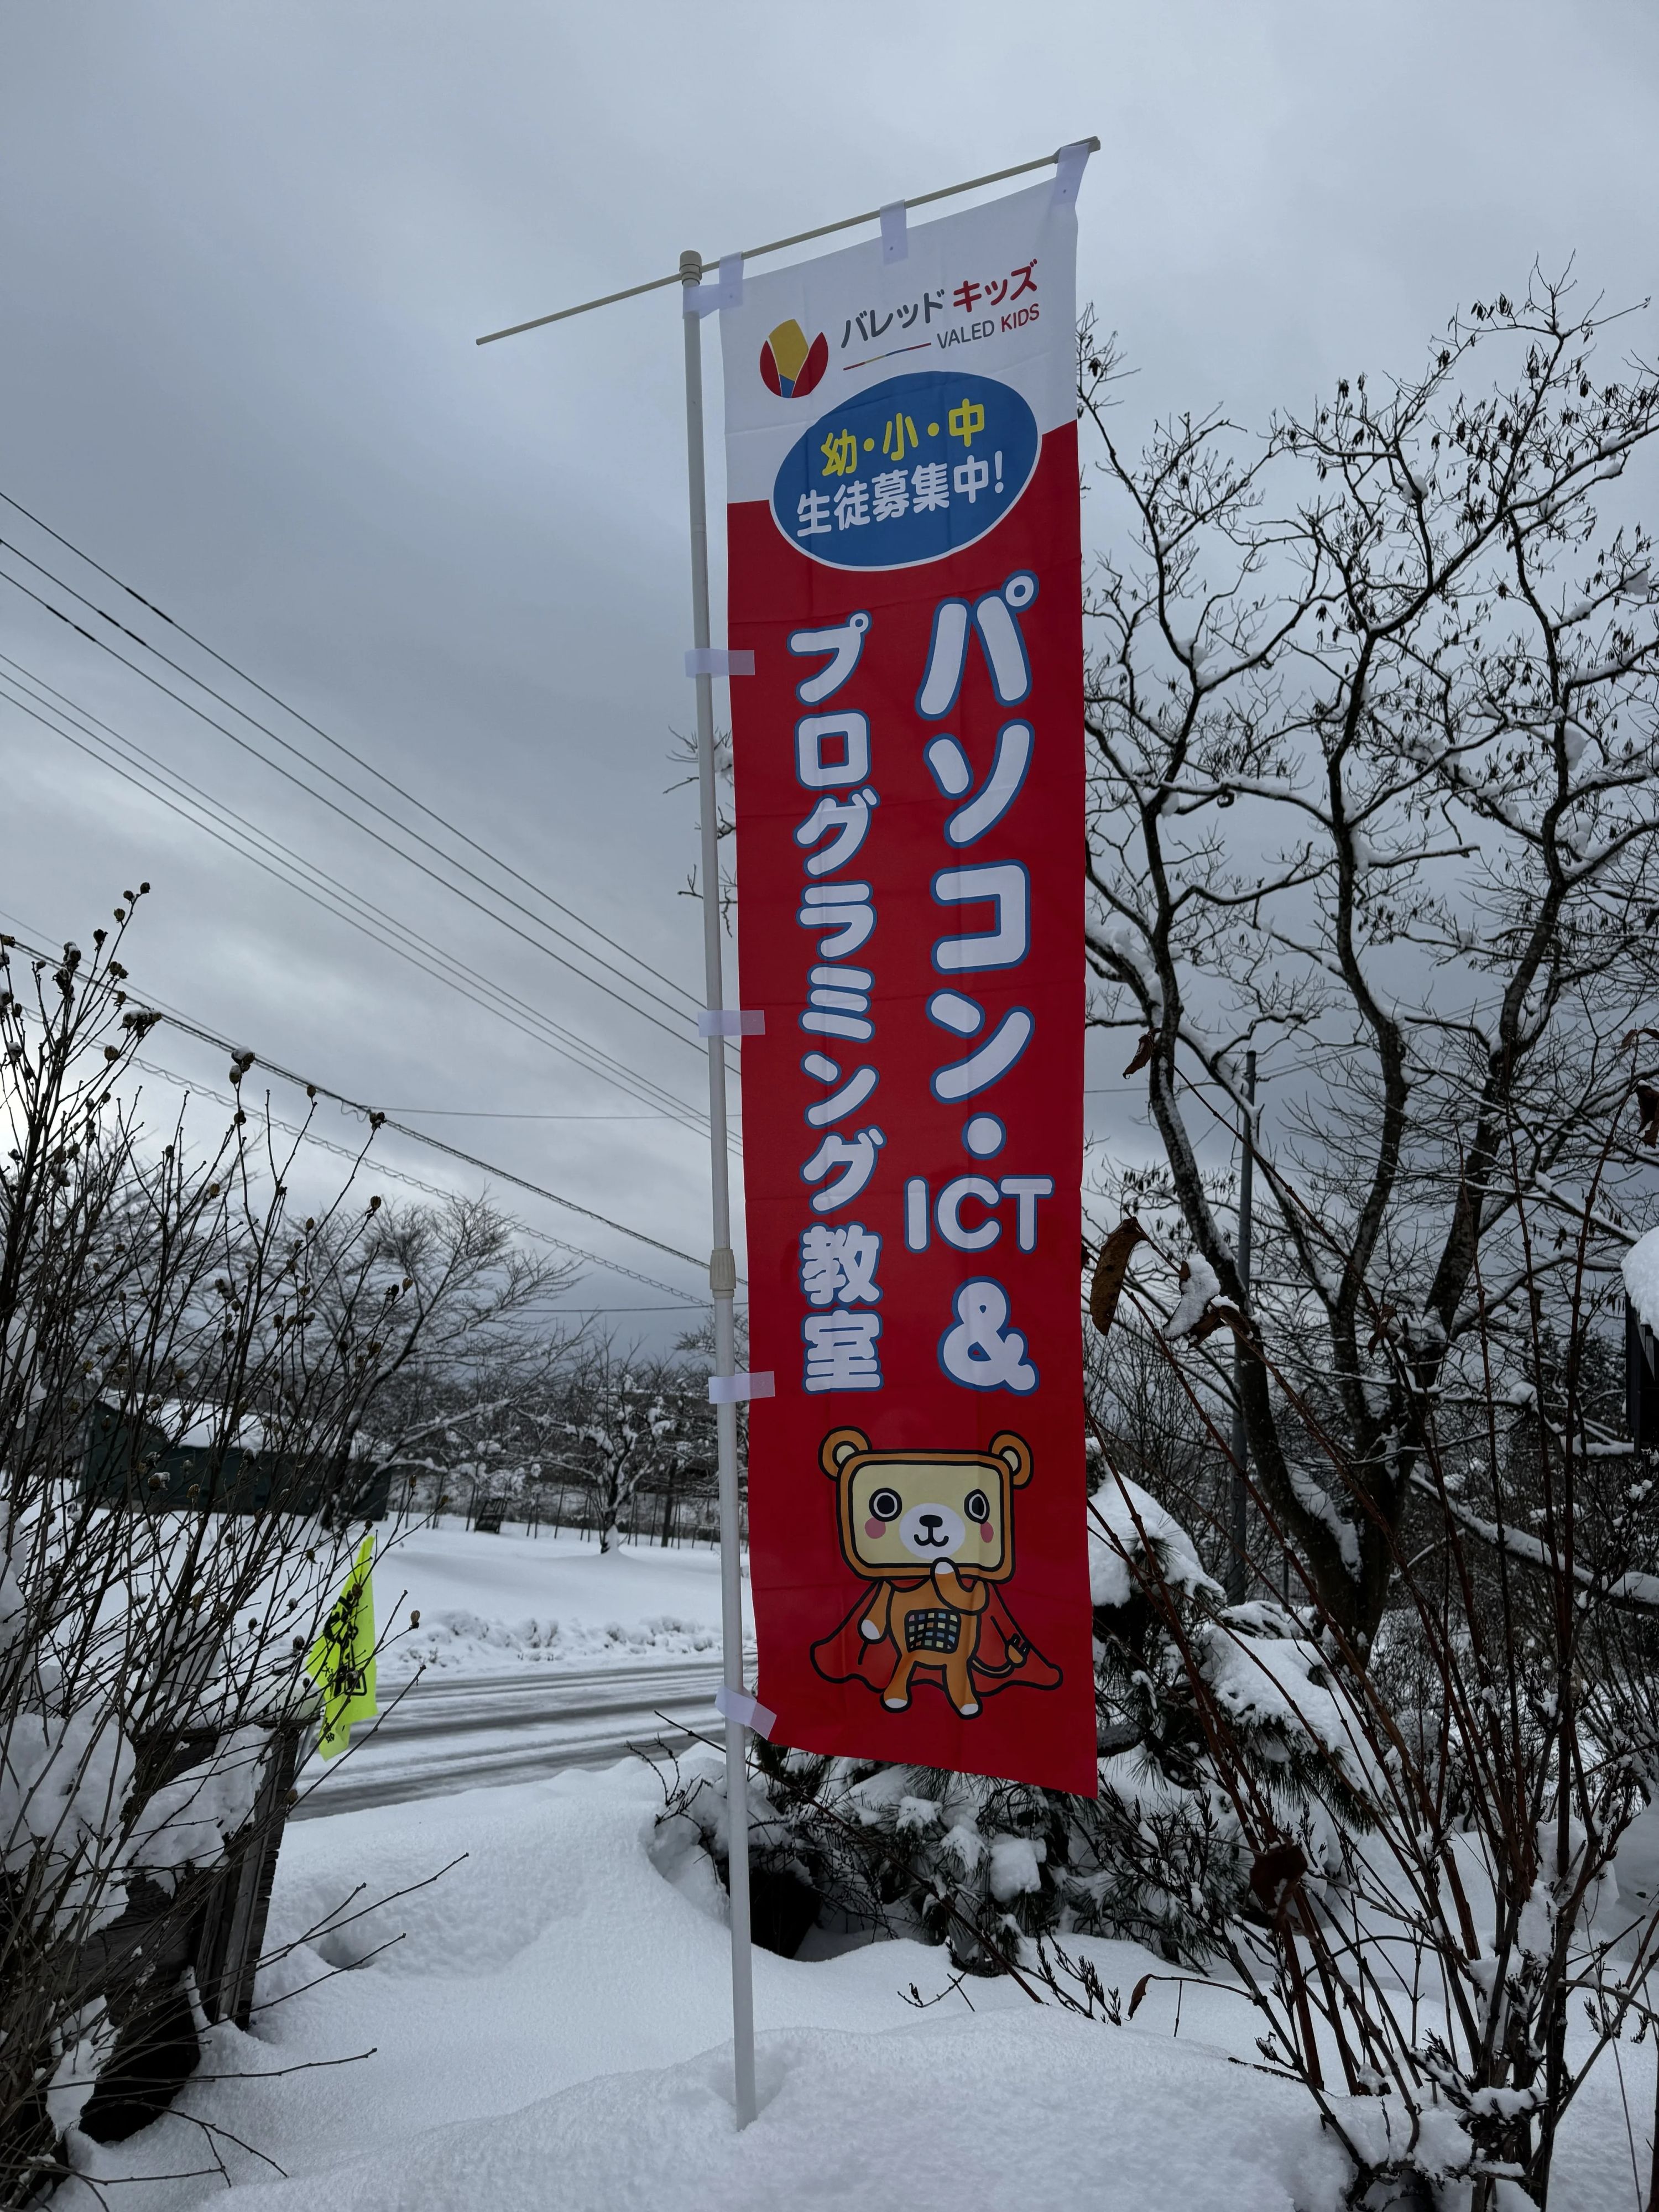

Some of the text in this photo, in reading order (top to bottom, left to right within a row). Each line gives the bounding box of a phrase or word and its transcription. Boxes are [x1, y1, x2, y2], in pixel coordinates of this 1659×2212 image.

[936, 303, 1040, 349] VALED KIDS
[797, 450, 1004, 538] 生徒募集中!
